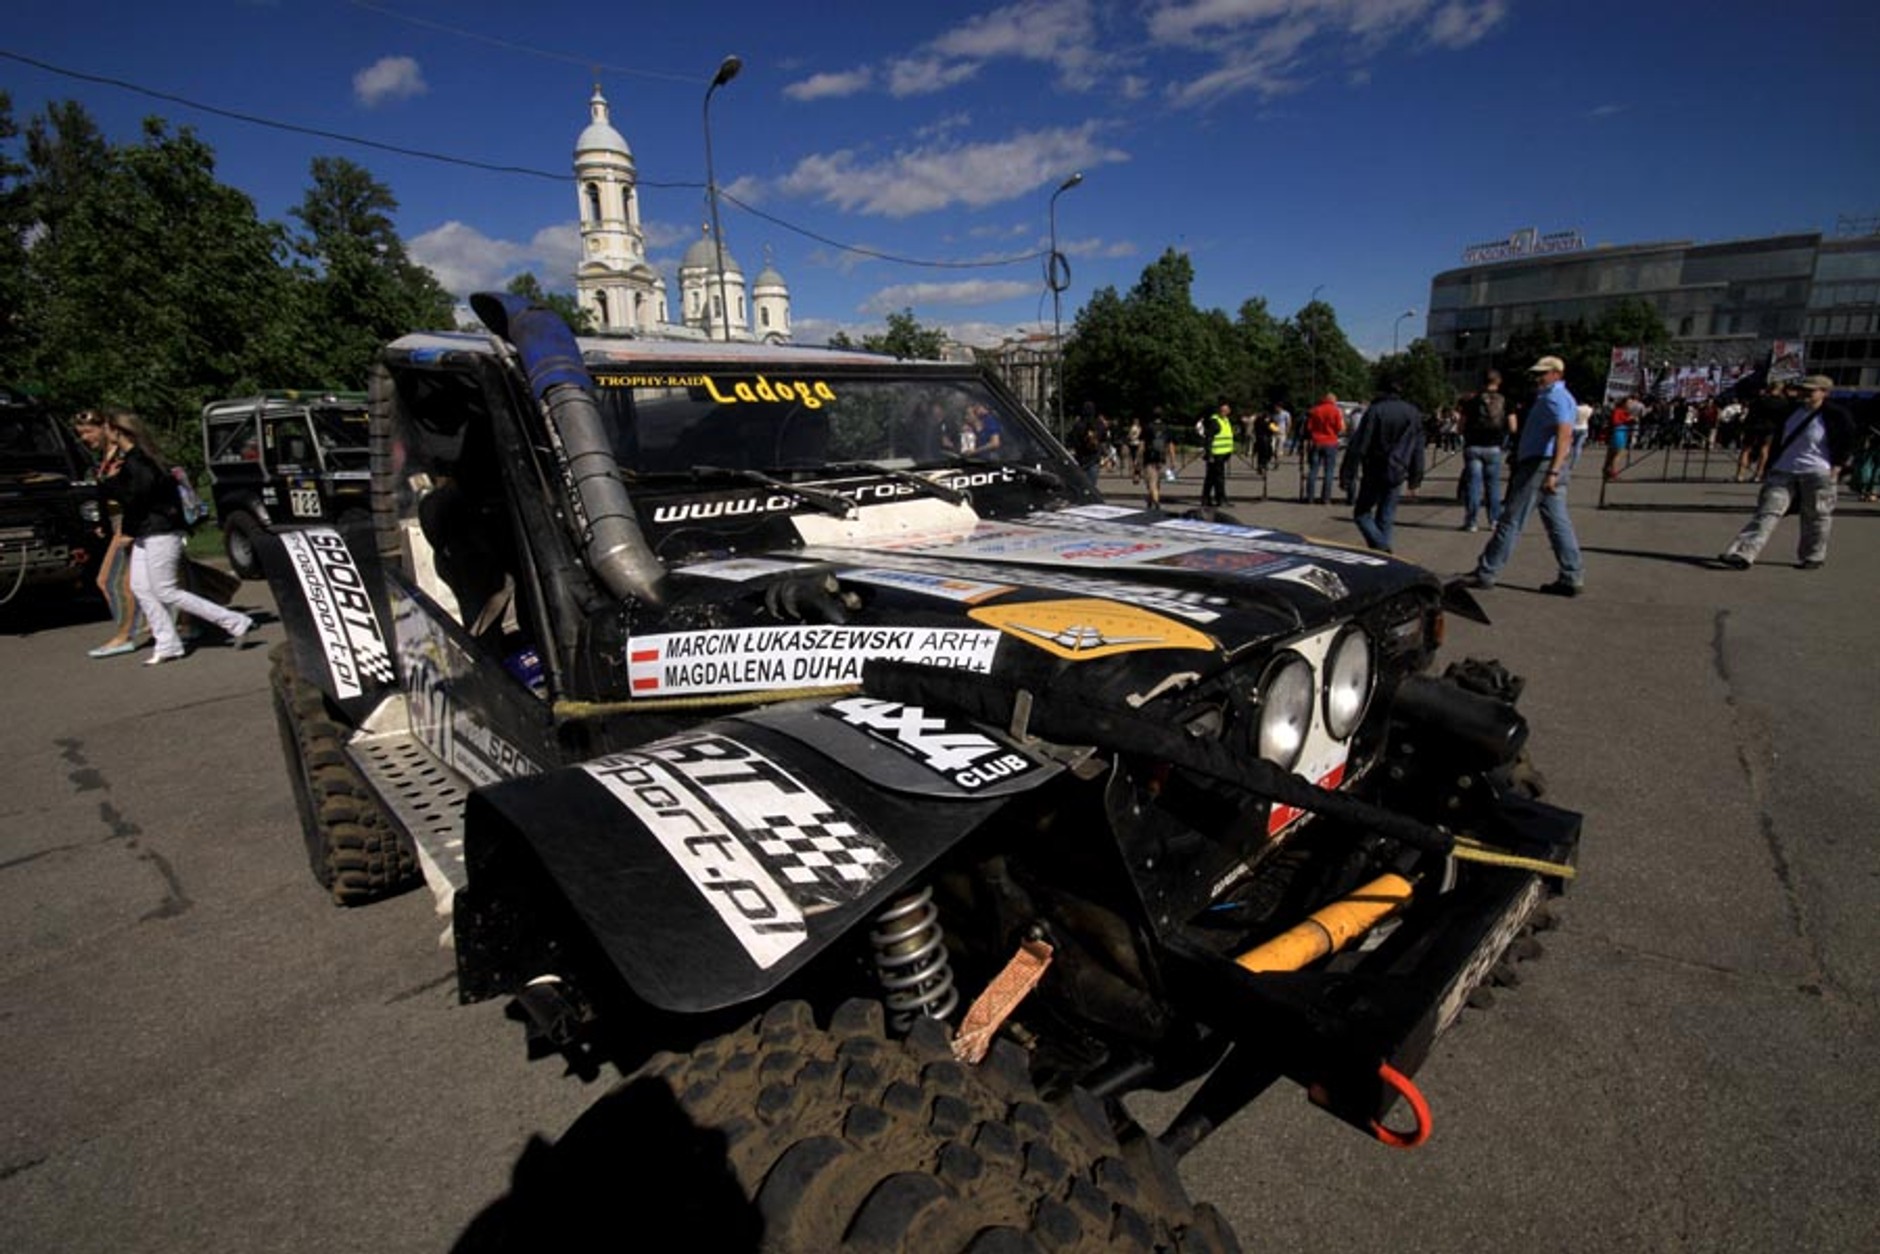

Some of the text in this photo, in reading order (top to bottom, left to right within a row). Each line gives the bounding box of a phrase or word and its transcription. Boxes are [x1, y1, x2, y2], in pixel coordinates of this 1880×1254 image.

[597, 374, 836, 409] TROPHY-RAID Ladoga
[310, 535, 382, 643] SPORT
[665, 630, 994, 659] MARCIN ŁUKASZEWSKI ARH+
[665, 658, 787, 687] MAGDALENA
[955, 753, 1029, 788] CLUB
